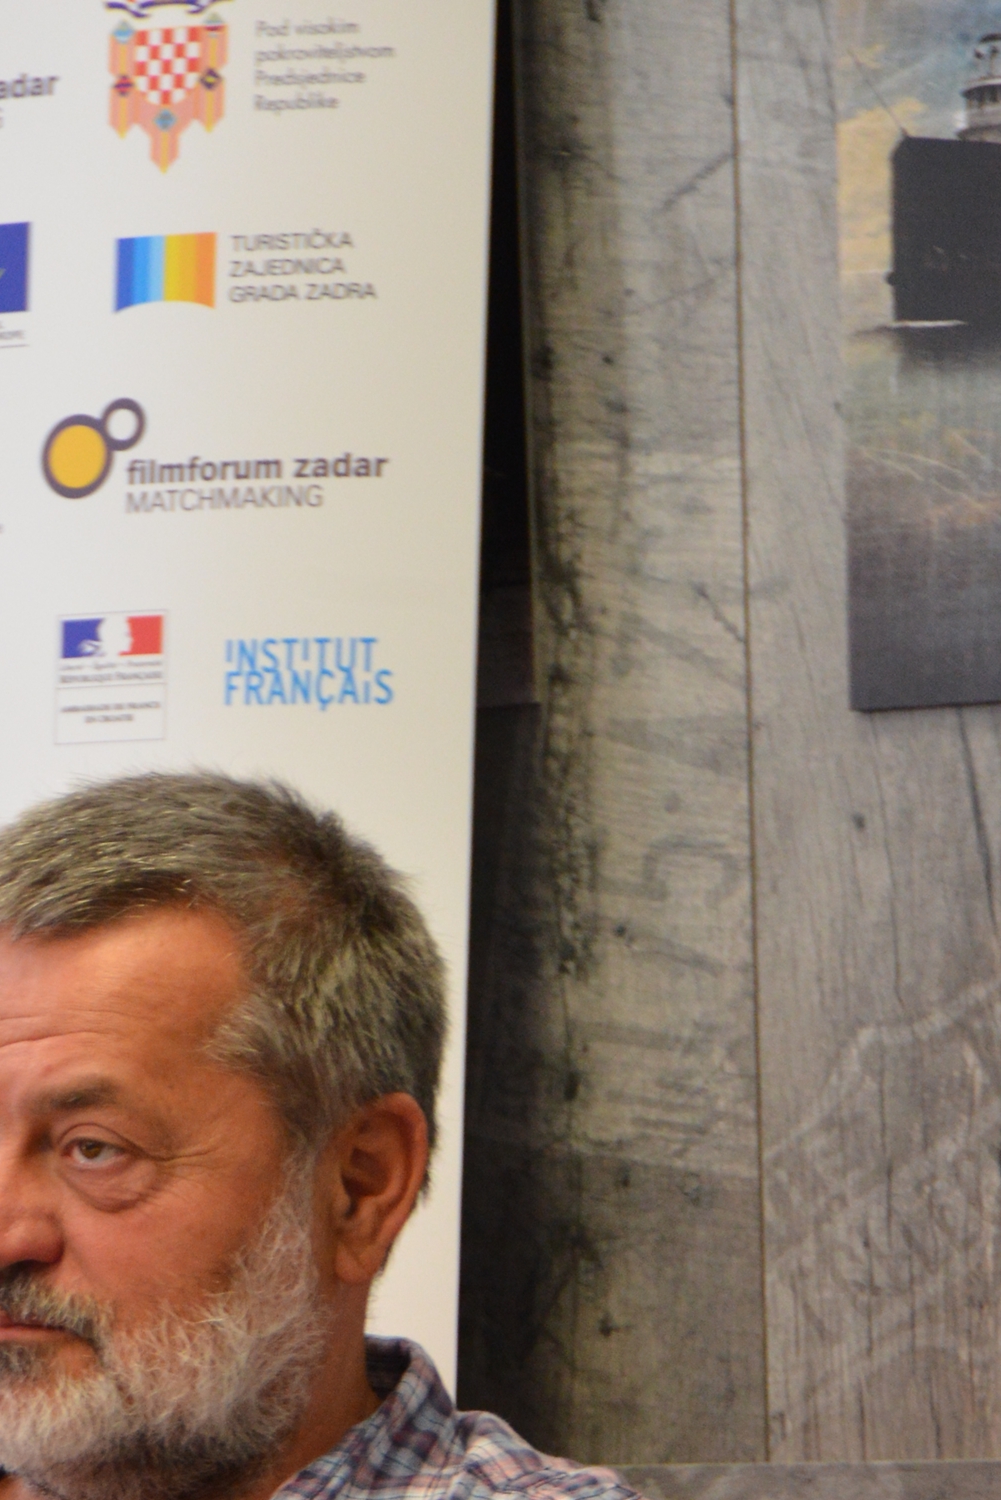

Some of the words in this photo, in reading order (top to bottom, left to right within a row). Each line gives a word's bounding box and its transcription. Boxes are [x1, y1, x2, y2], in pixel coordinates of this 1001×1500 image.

[231, 227, 354, 254] TURISTIČKA
[230, 257, 347, 279] ZAJEDNICA
[229, 283, 300, 303] GRADA
[305, 281, 377, 301] ZADRA
[126, 456, 282, 486] filmforum
[293, 452, 389, 479] zadar
[125, 483, 325, 515] MATCHMAKING
[224, 637, 377, 673] INSTITUT
